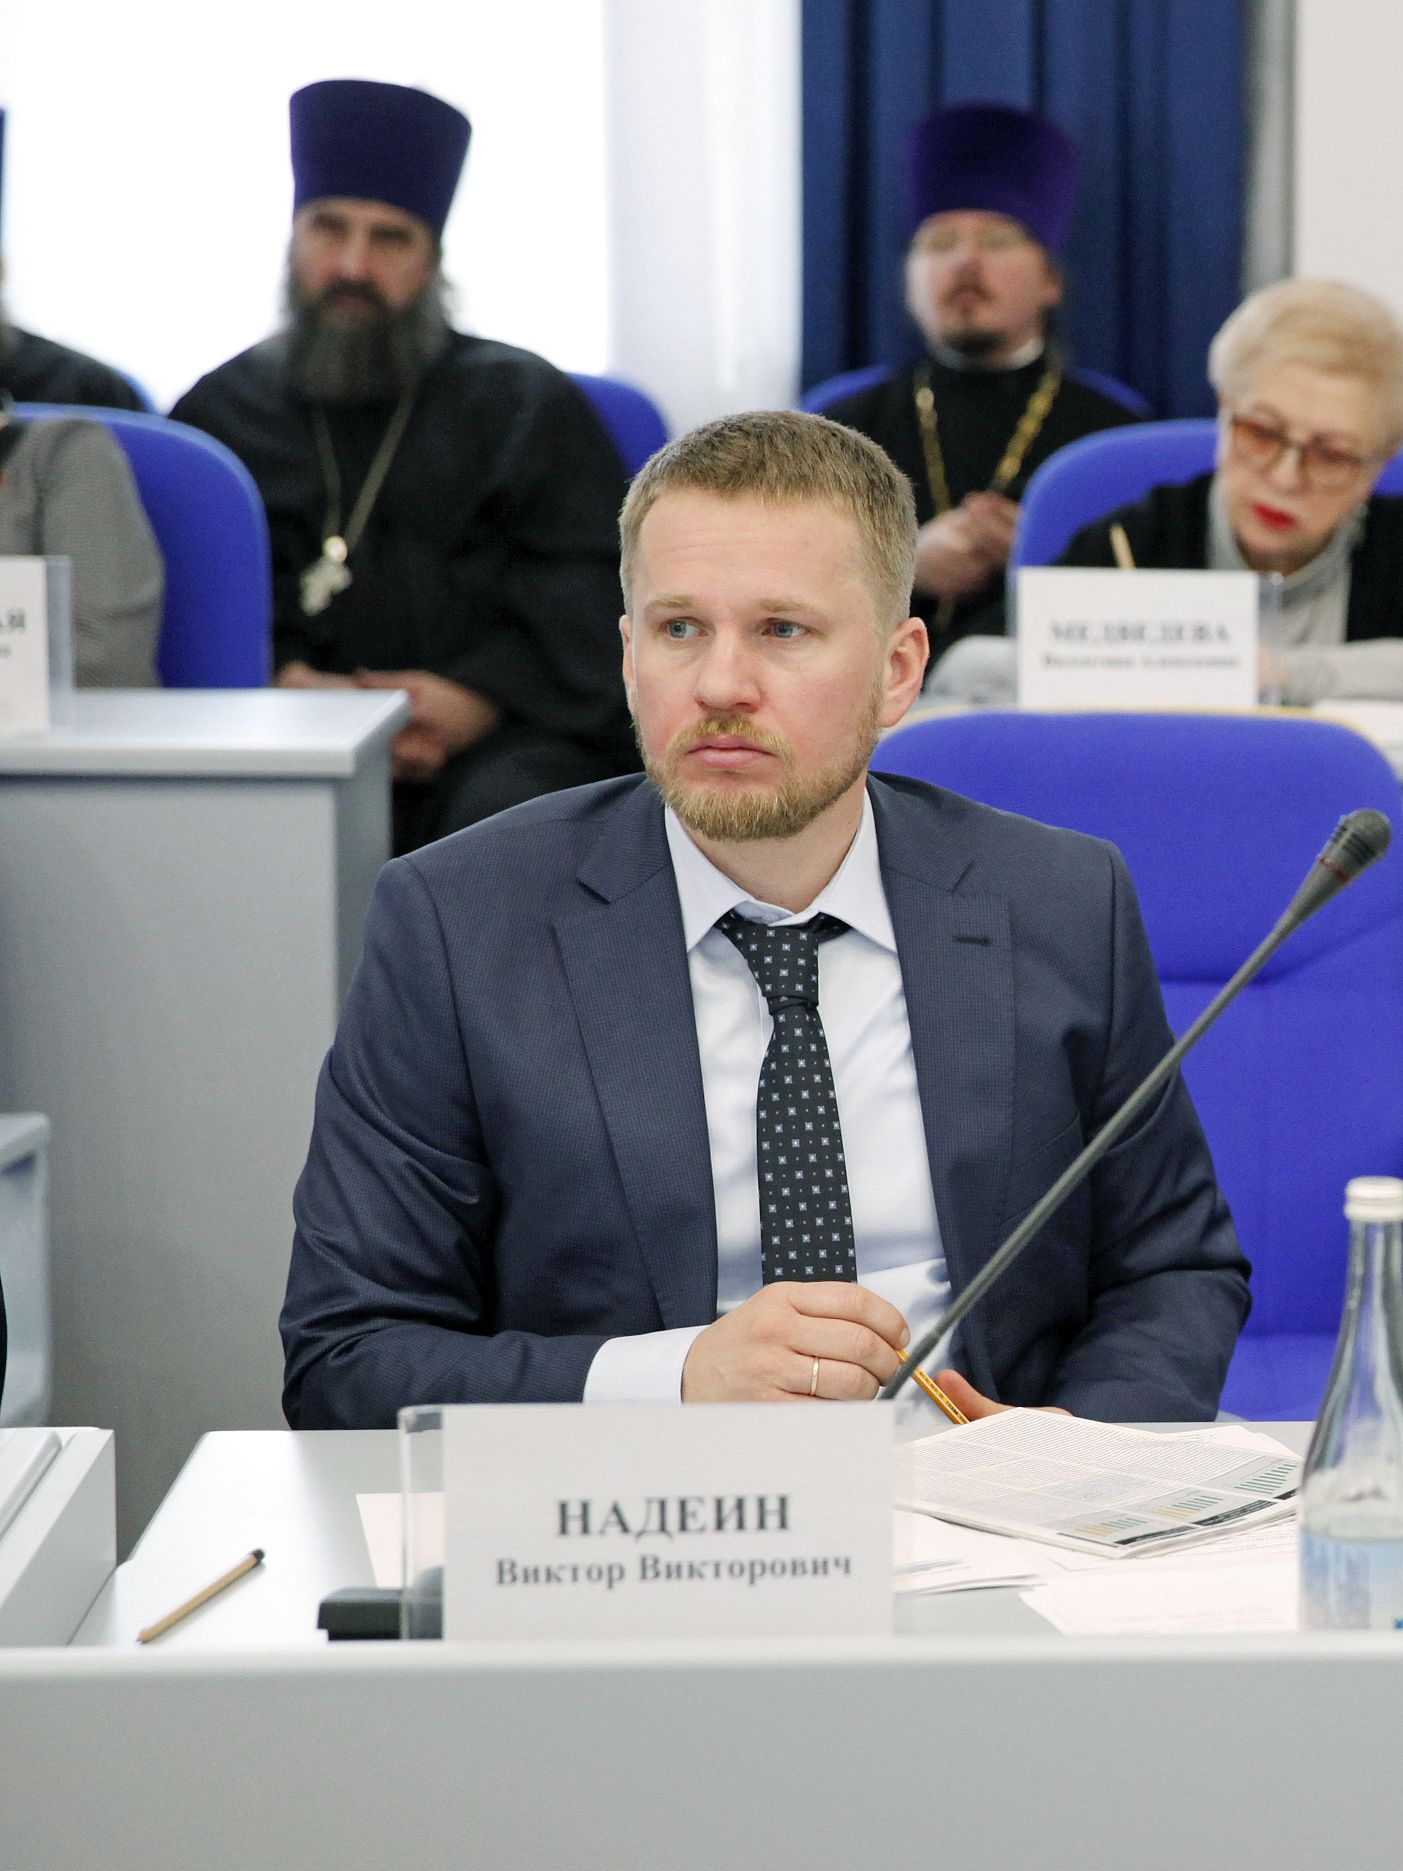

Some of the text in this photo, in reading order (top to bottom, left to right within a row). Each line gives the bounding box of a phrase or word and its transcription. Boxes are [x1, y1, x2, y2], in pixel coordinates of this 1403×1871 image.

[556, 1494, 791, 1540] НАДЕИН
[496, 1554, 852, 1591] Виктор Викторович
